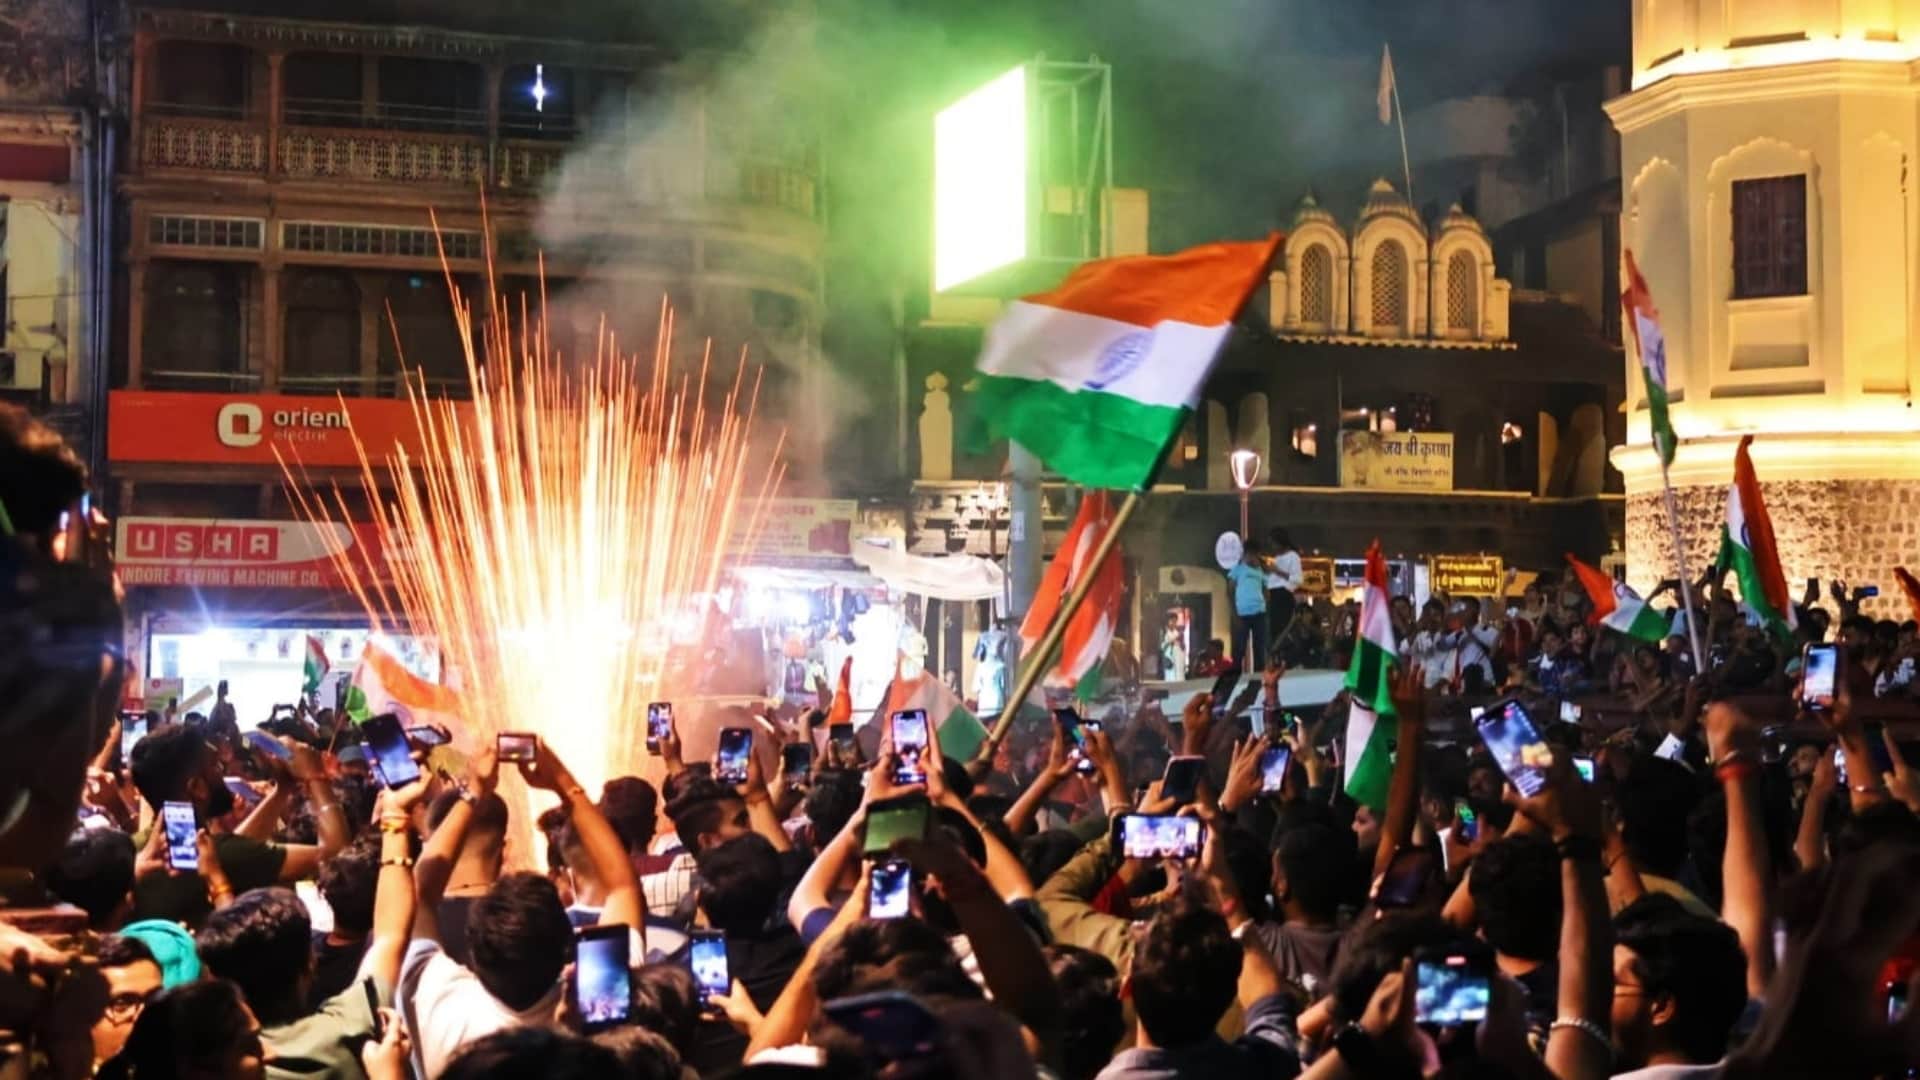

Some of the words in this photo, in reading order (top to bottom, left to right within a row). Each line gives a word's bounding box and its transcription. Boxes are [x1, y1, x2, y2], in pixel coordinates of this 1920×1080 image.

[273, 407, 349, 427] orient
[1383, 441, 1402, 455] जय
[135, 529, 270, 555] USHA
[119, 567, 171, 584] INDORE
[175, 568, 229, 585] SEWING
[233, 569, 299, 585] MACHINE
